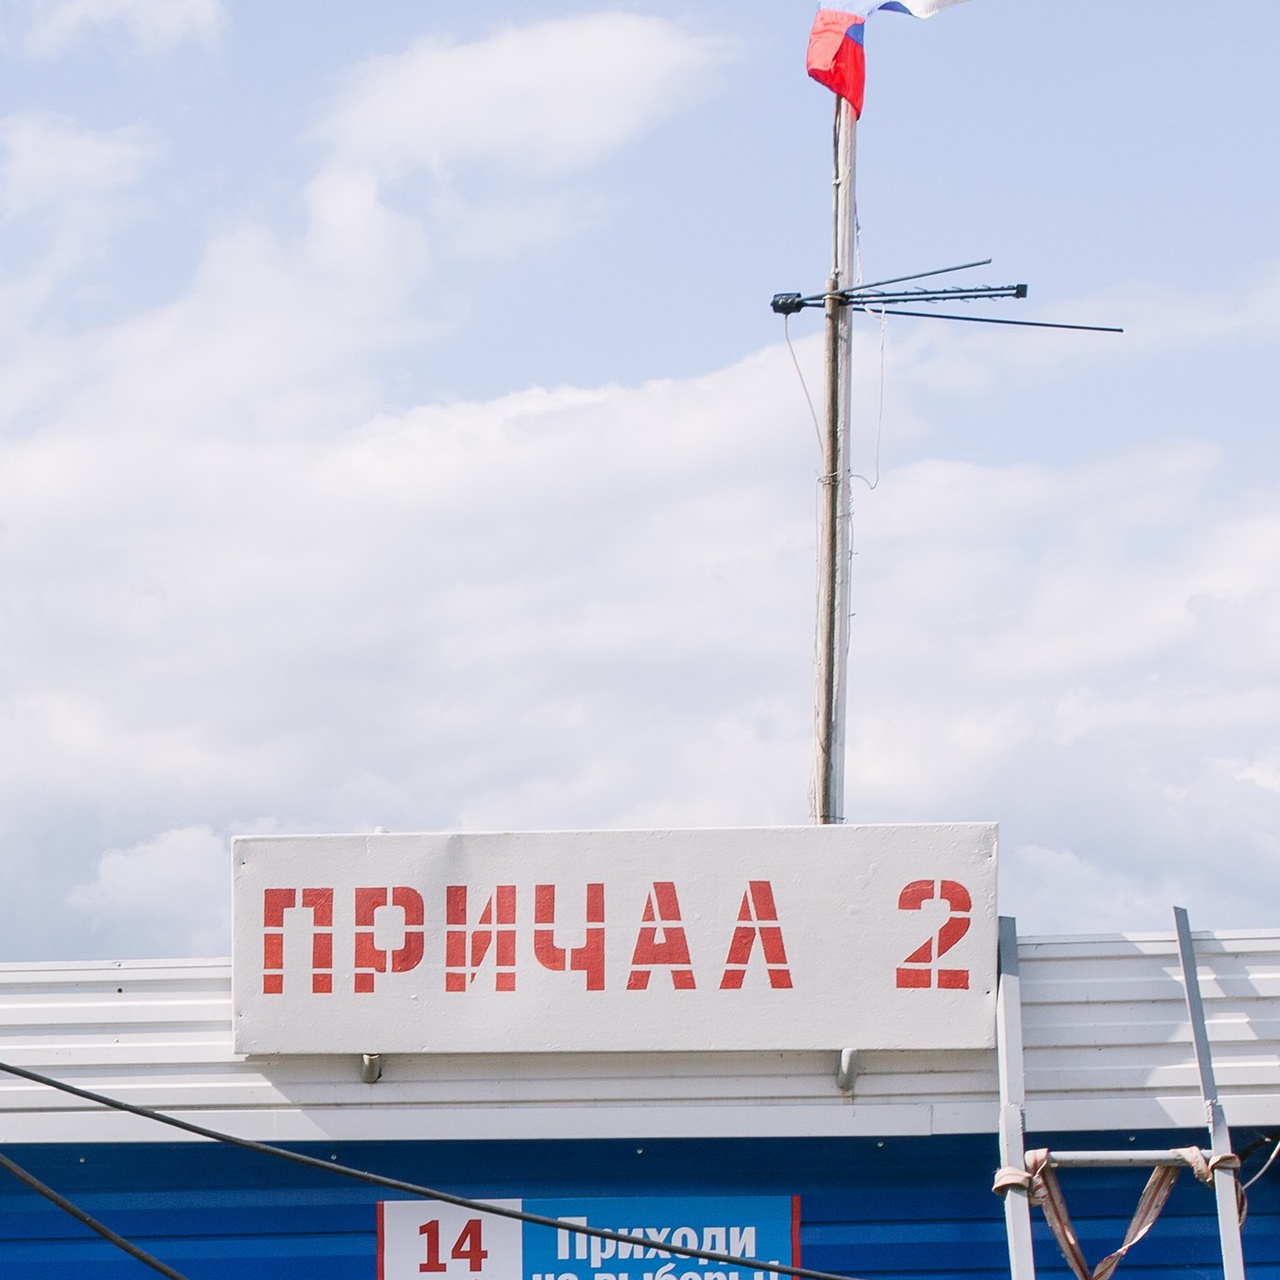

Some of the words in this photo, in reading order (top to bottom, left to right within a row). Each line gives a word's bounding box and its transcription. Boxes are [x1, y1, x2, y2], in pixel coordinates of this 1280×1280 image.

[263, 880, 793, 994] ПРИЧАЛ
[895, 879, 972, 990] 2
[418, 1218, 489, 1273] 14
[556, 1216, 756, 1268] Приходи
